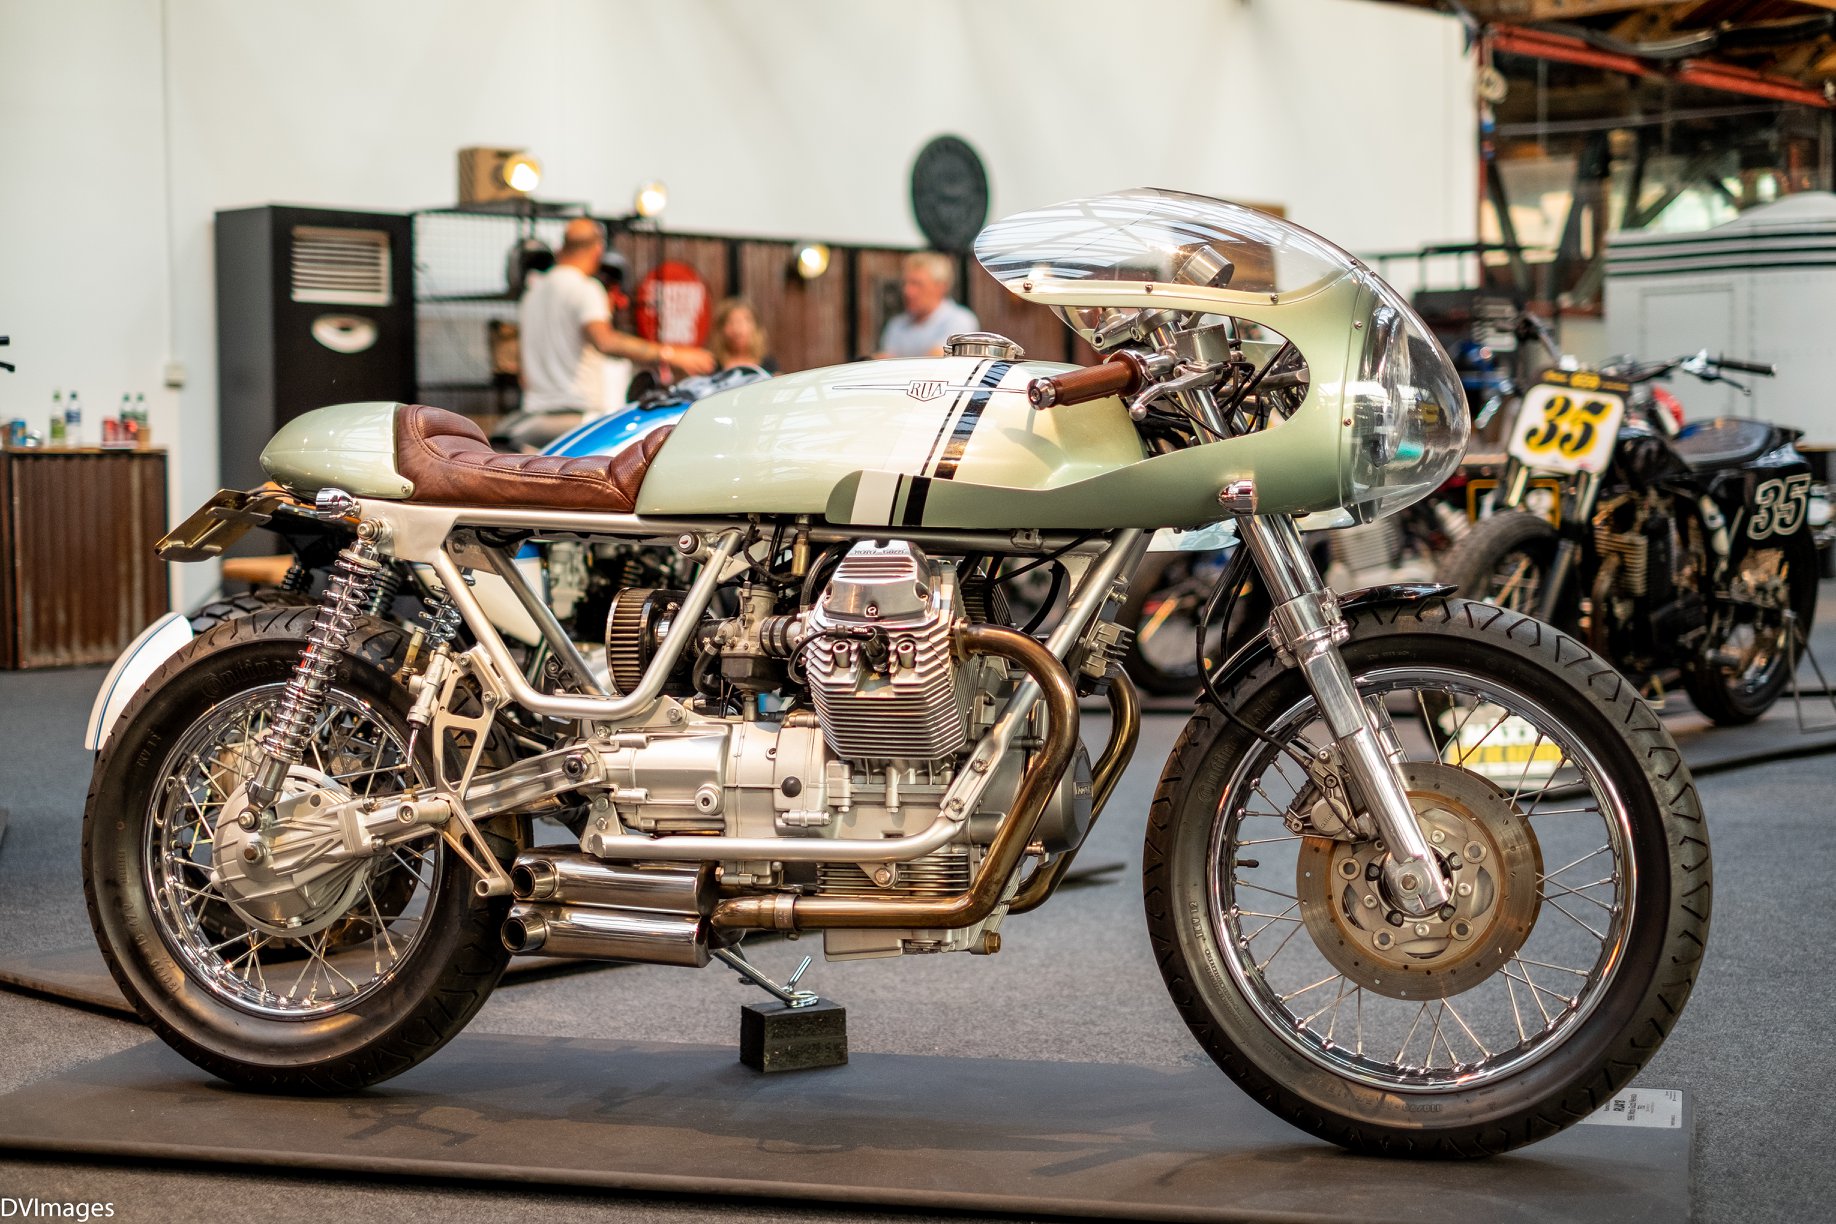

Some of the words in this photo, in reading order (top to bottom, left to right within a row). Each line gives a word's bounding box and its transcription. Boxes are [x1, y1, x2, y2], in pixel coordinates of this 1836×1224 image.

[910, 382, 943, 399] RUA
[1525, 395, 1612, 458] 35
[1747, 473, 1811, 540] 35
